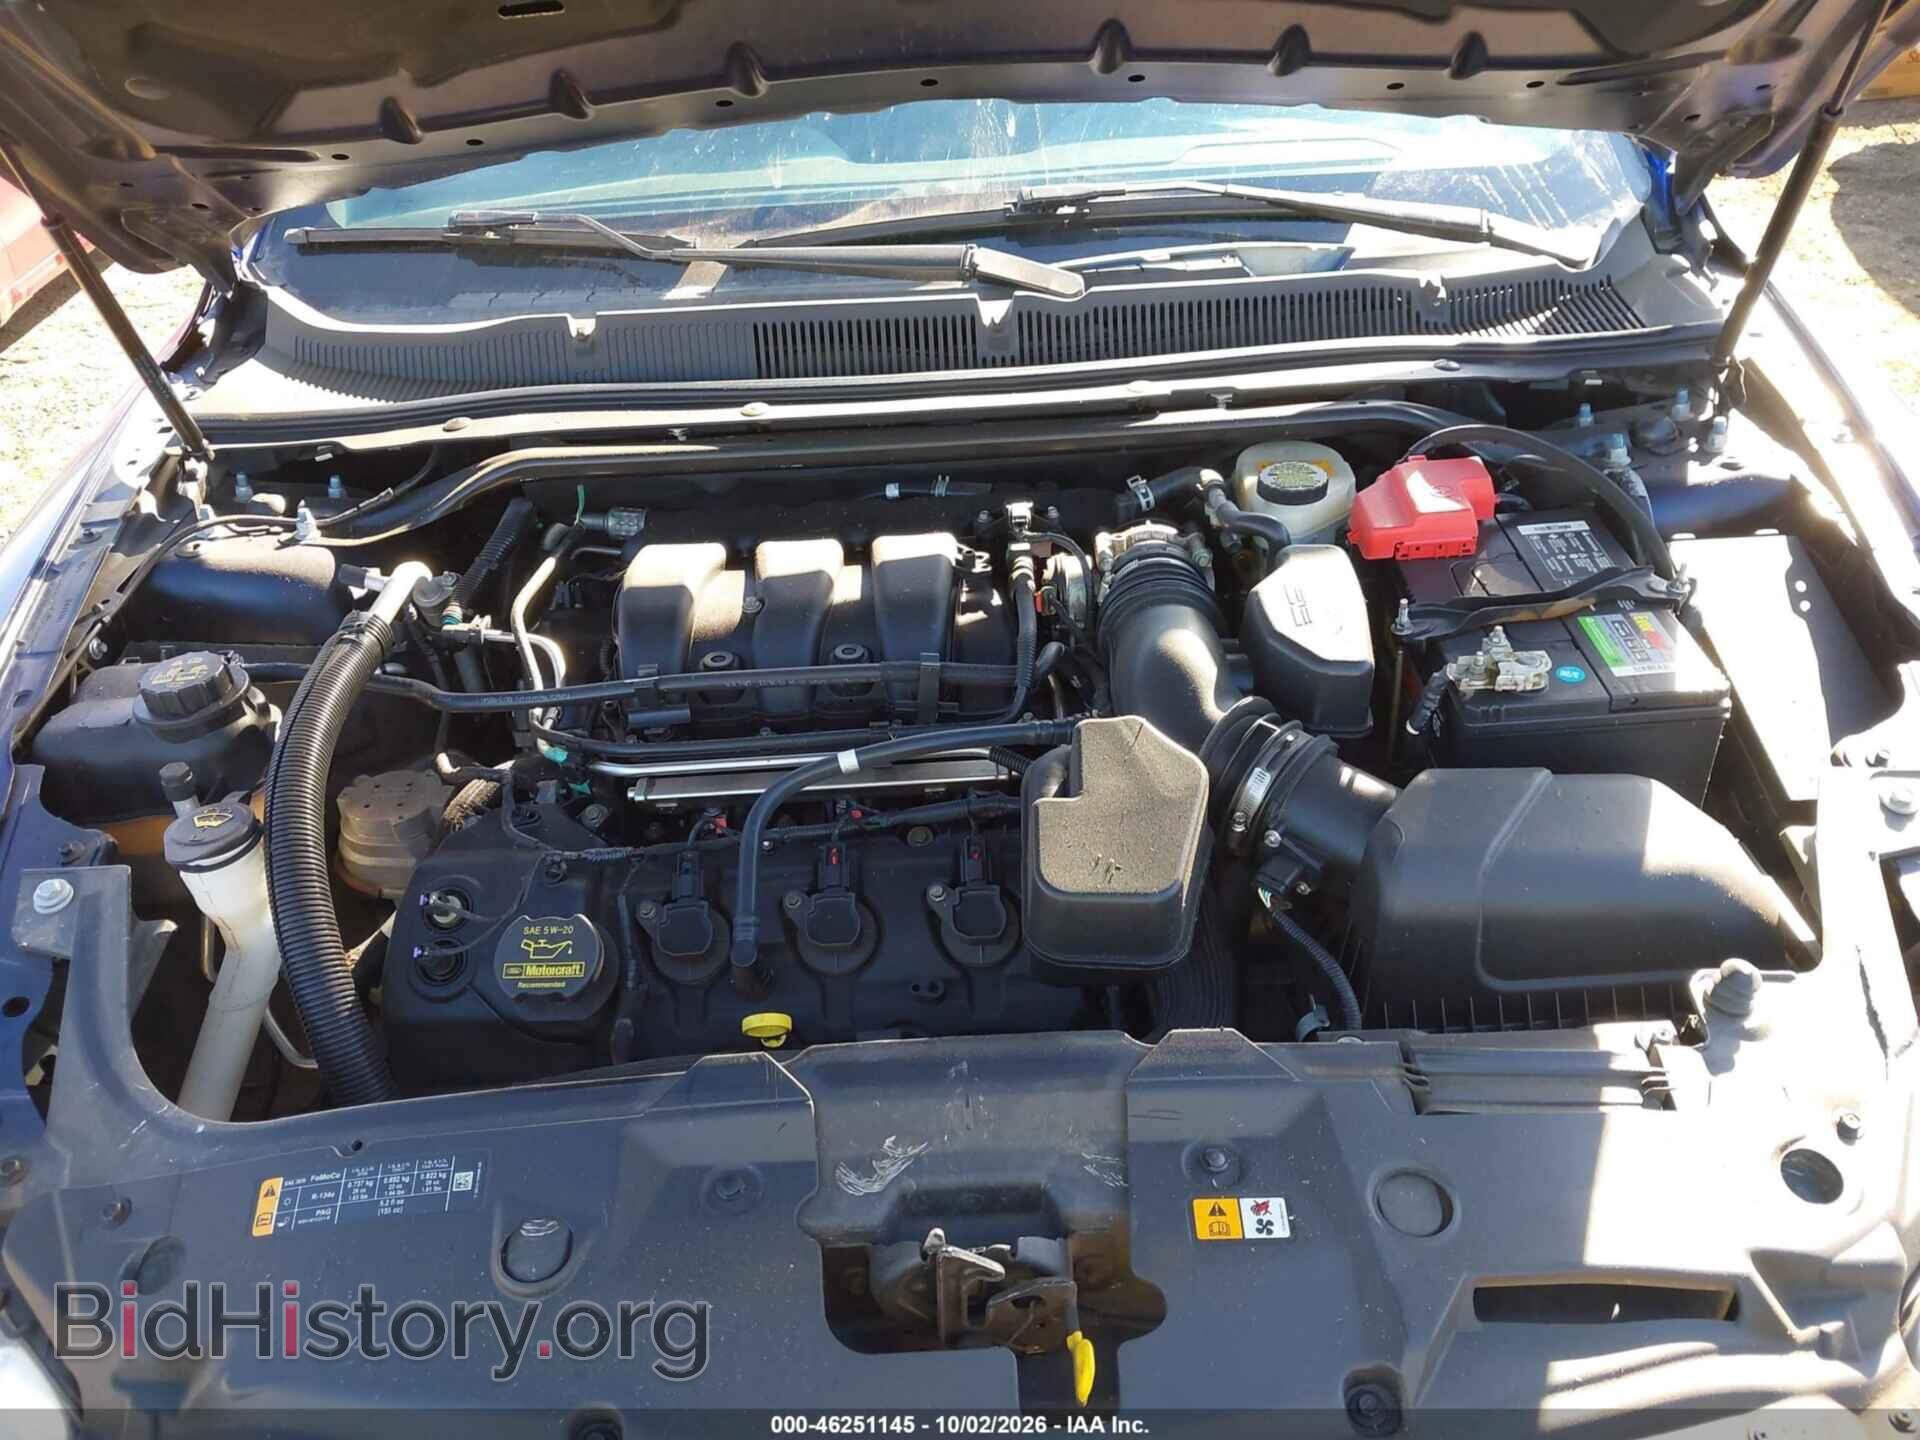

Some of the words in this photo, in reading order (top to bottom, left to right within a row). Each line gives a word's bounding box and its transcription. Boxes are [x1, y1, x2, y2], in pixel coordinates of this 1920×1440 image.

[523, 926, 541, 935] SAE
[525, 964, 581, 977] Motorcraft
[517, 981, 566, 989] Recommended
